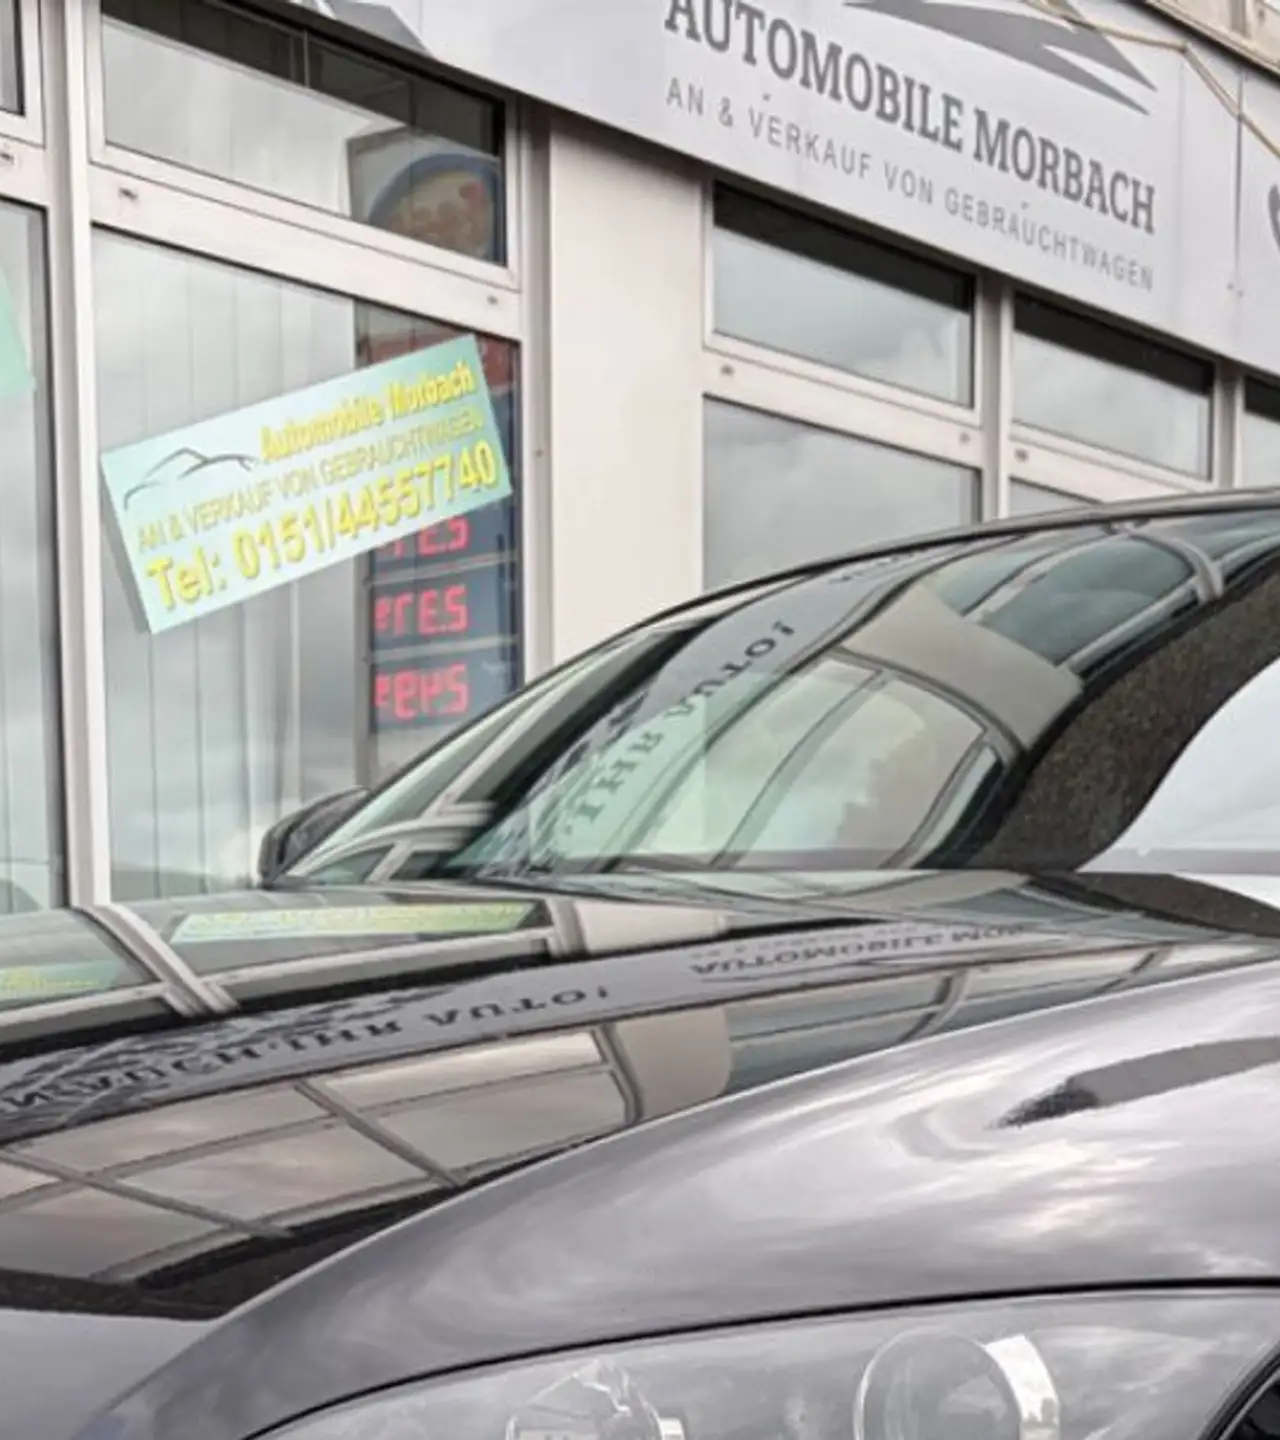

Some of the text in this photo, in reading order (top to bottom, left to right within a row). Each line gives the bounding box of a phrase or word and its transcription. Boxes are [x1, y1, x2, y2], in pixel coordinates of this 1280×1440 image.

[664, 0, 1156, 234] AUTOMOBILE MORBACH
[666, 77, 1154, 292] AN & VERKAUF VON GEBRAUCHTWAGEN
[261, 359, 476, 463] Automobile Morbach
[185, 479, 274, 536] VERKAUF
[277, 463, 320, 499] VON
[145, 545, 228, 610] Tel:
